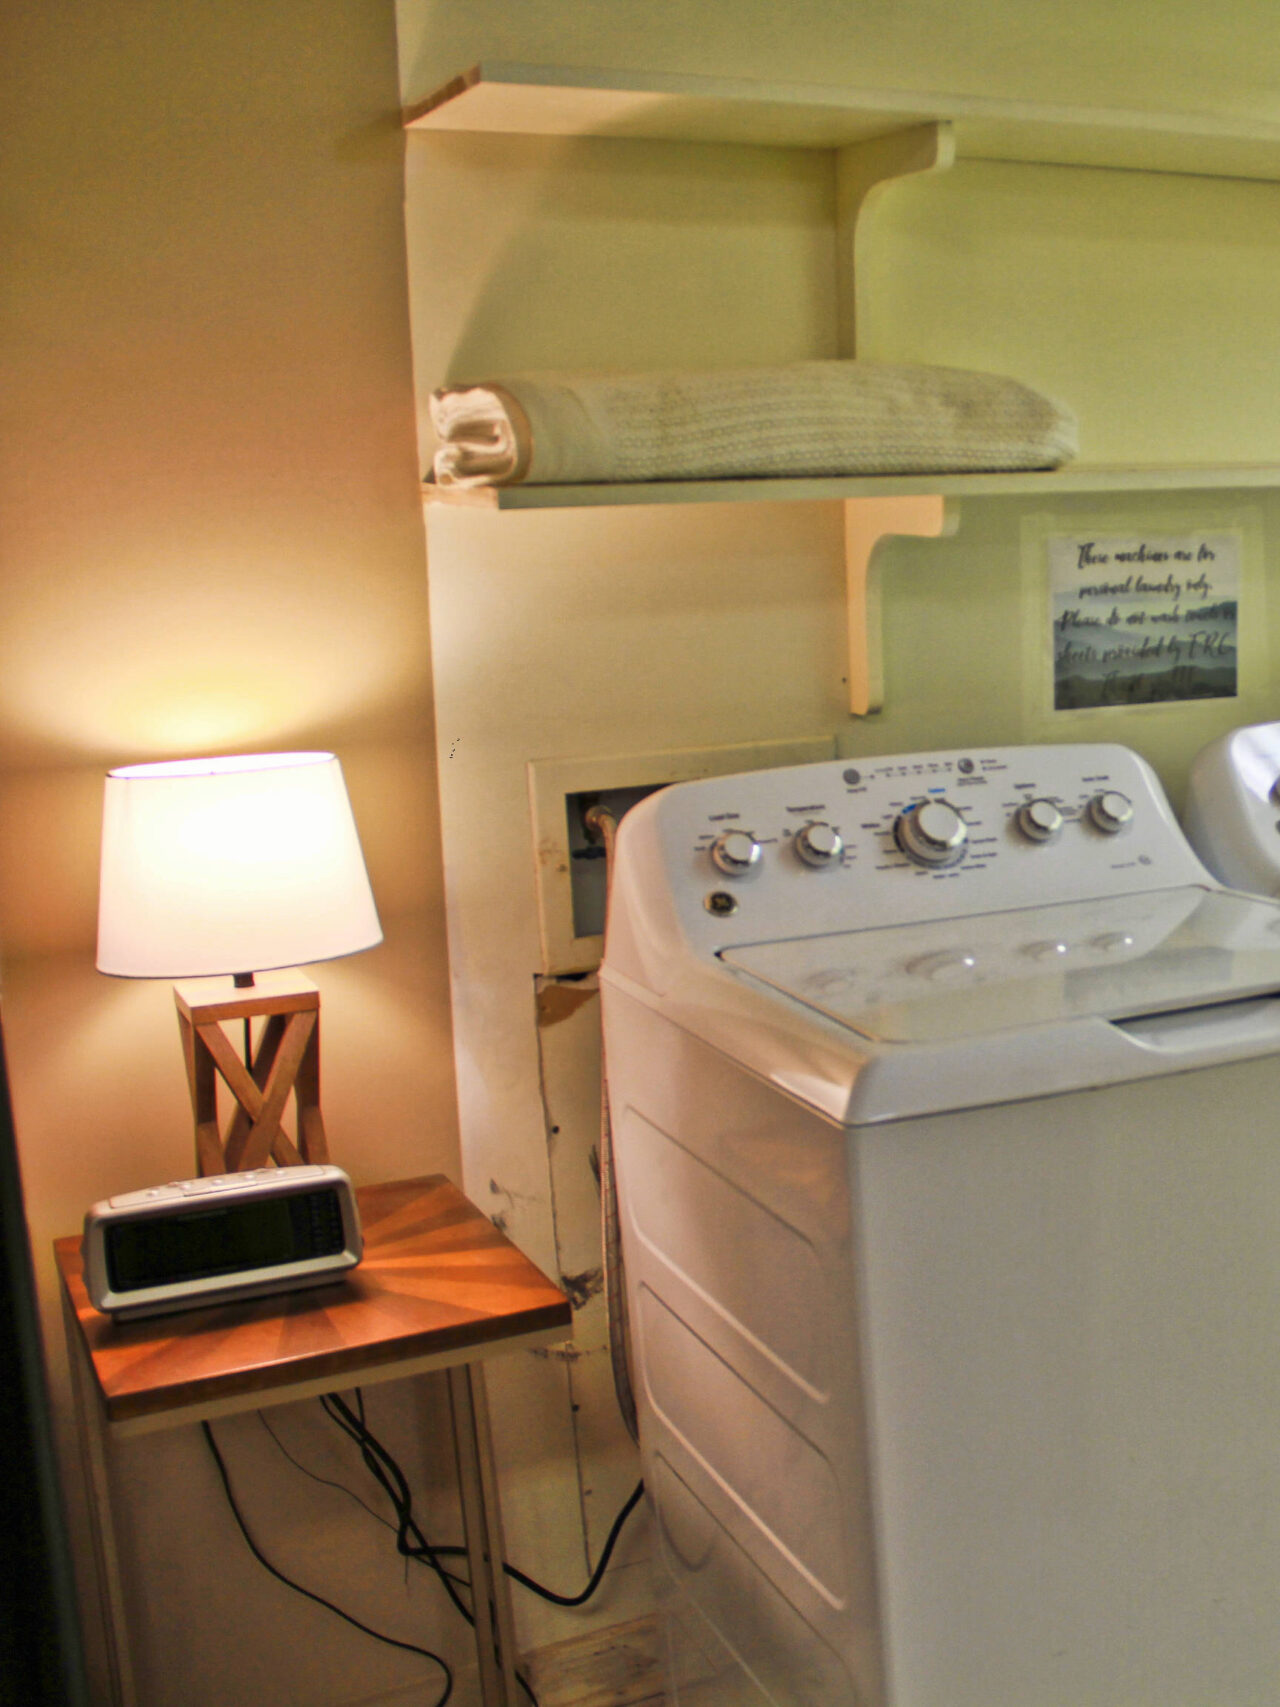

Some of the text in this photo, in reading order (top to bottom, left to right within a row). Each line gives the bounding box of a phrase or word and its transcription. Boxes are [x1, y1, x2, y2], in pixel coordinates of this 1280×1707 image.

[1115, 543, 1169, 563] machines
[1078, 575, 1133, 599] personal
[1135, 573, 1181, 600] laundry
